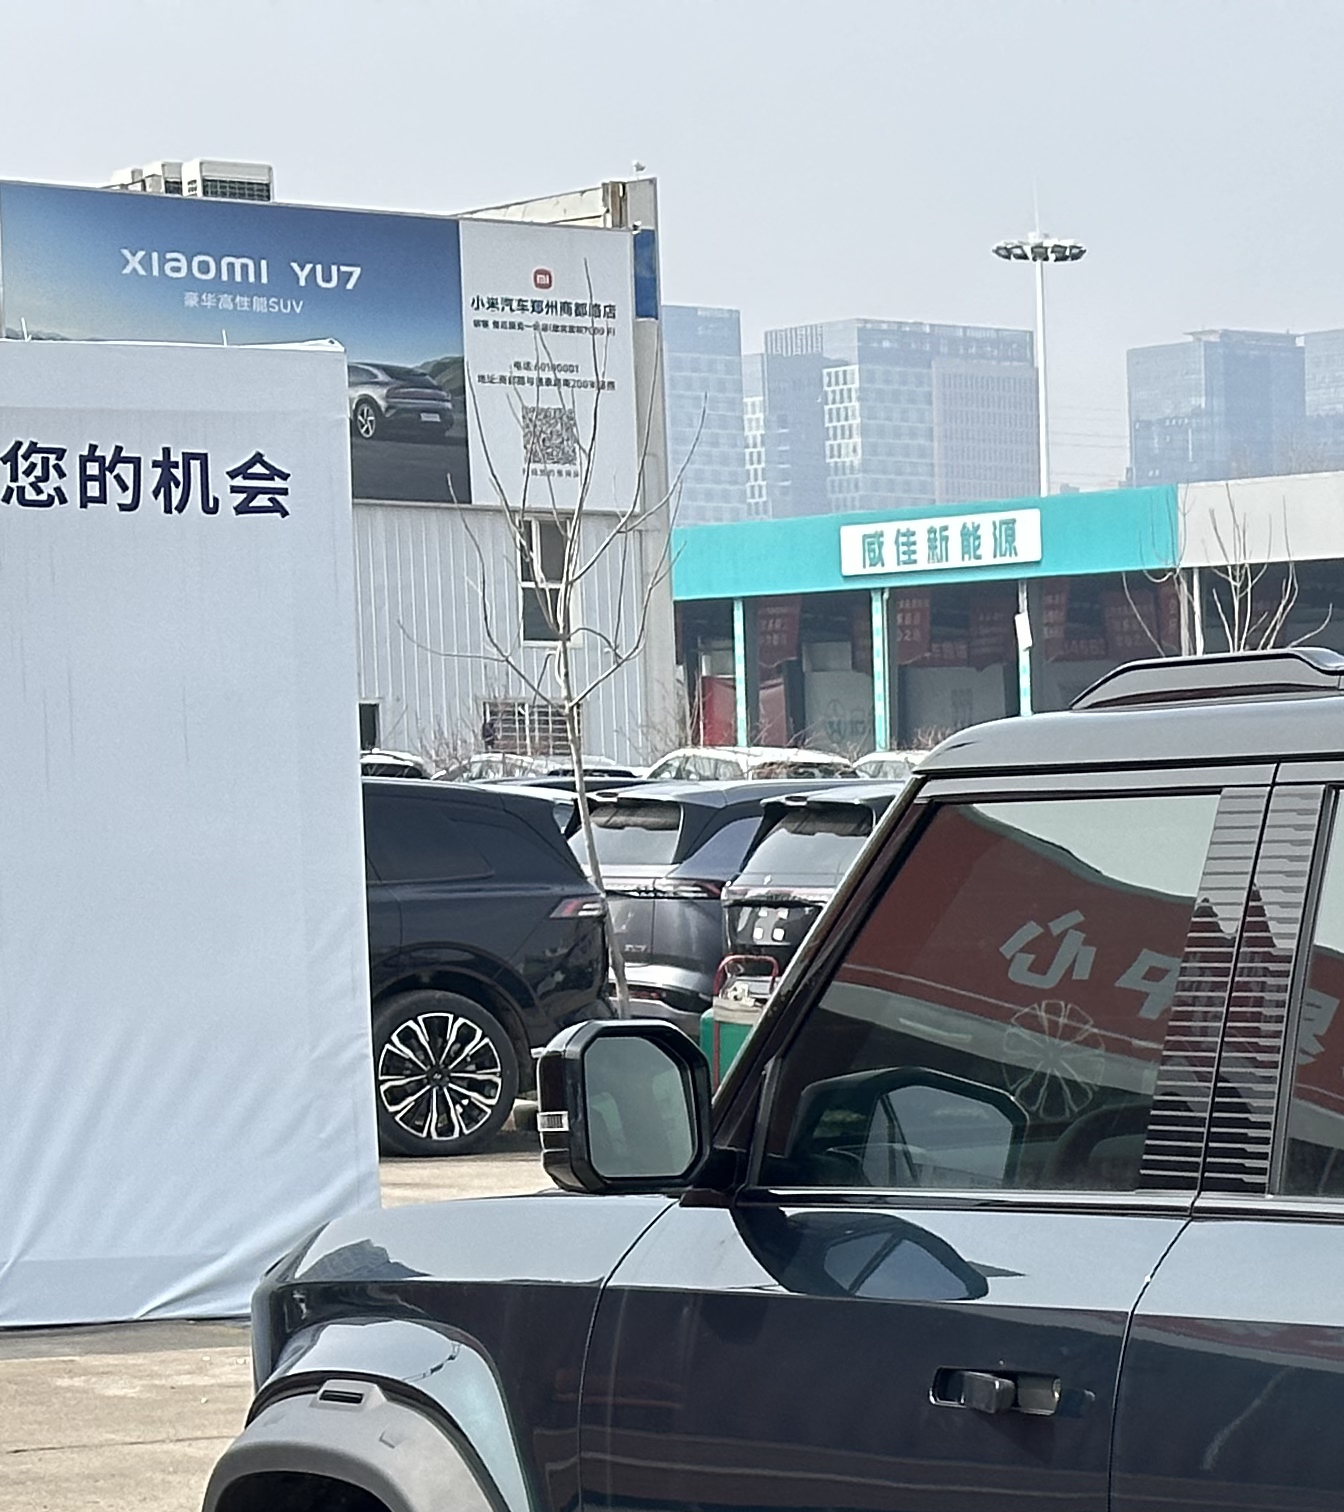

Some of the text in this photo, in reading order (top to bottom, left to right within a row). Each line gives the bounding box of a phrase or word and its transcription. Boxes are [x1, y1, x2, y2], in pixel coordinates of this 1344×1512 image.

[291, 262, 362, 290] YU7
[184, 291, 304, 314] 豪华高性能SUV
[0, 440, 291, 518] 您的机会
[862, 518, 1018, 569] 威佳新能源
